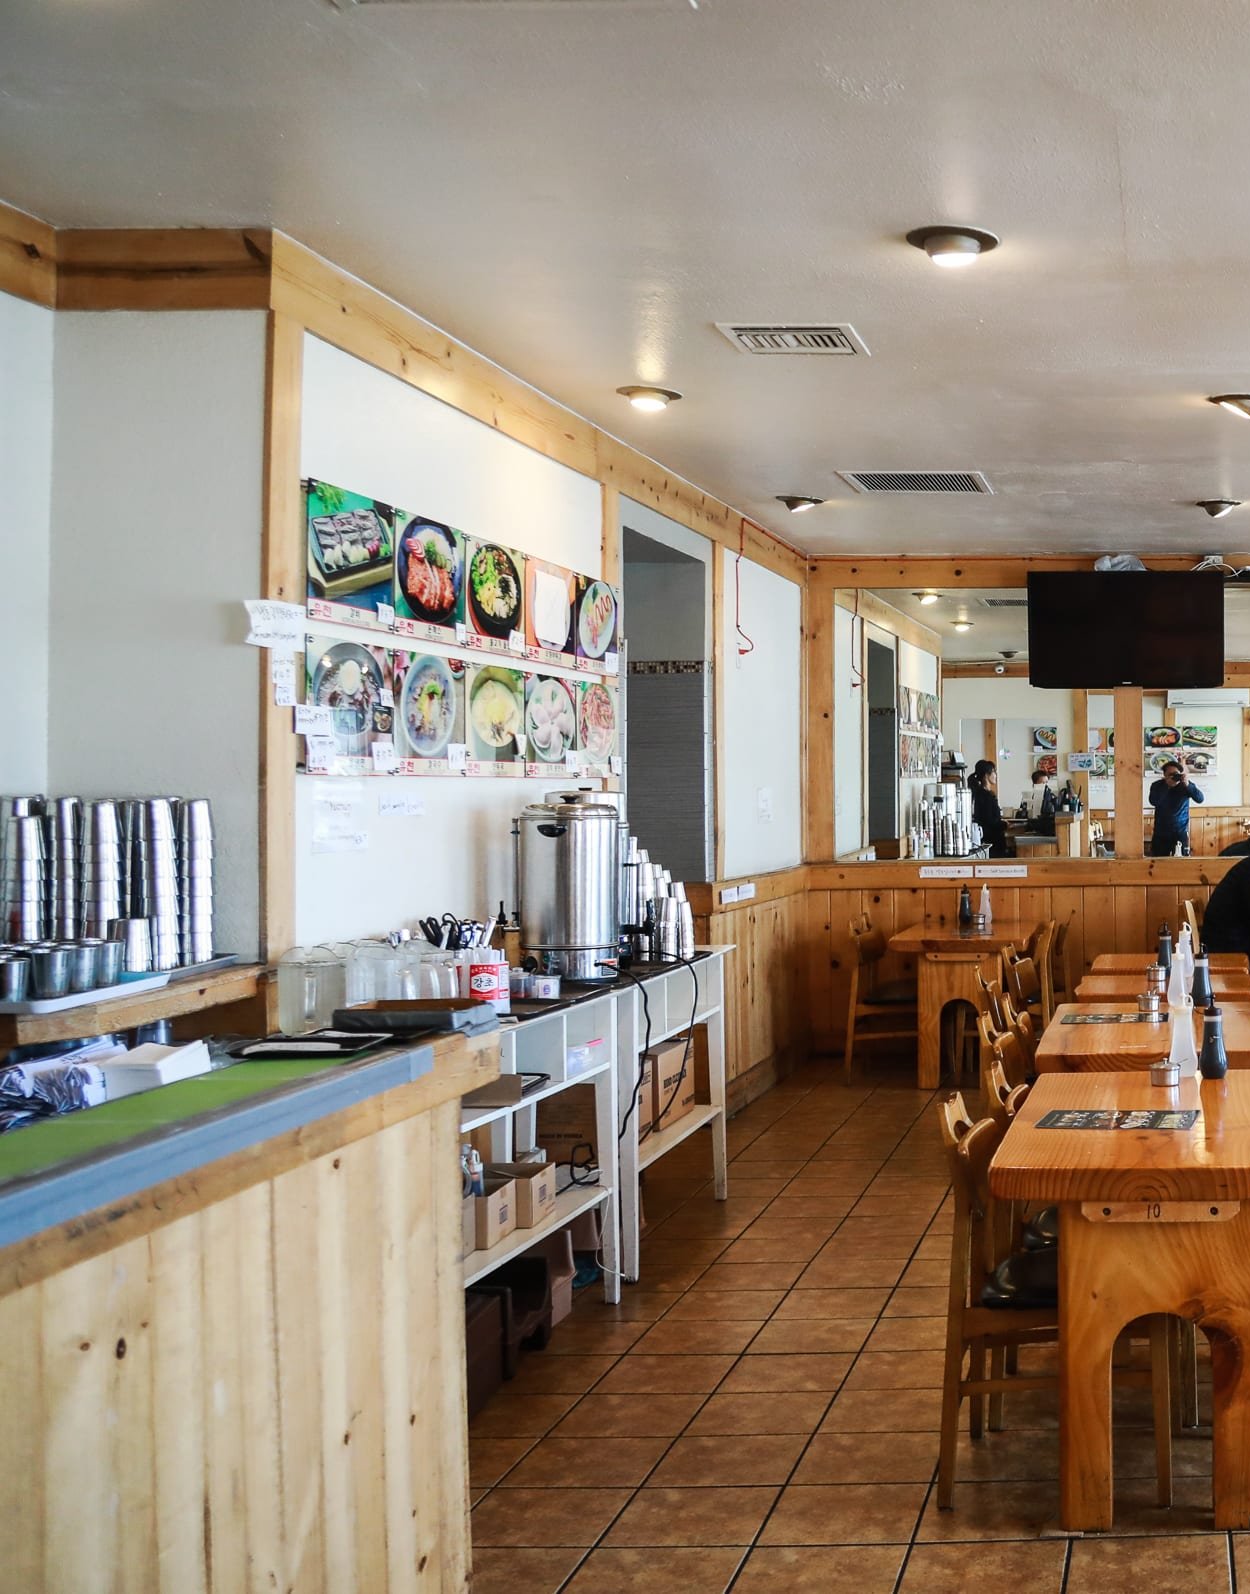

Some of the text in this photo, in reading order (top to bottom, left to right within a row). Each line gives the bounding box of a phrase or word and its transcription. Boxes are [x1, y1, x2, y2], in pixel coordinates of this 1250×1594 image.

[399, 620, 414, 634] 유천
[399, 760, 414, 773] 유천
[473, 977, 494, 989] 강초
[1147, 1203, 1161, 1220] 10
